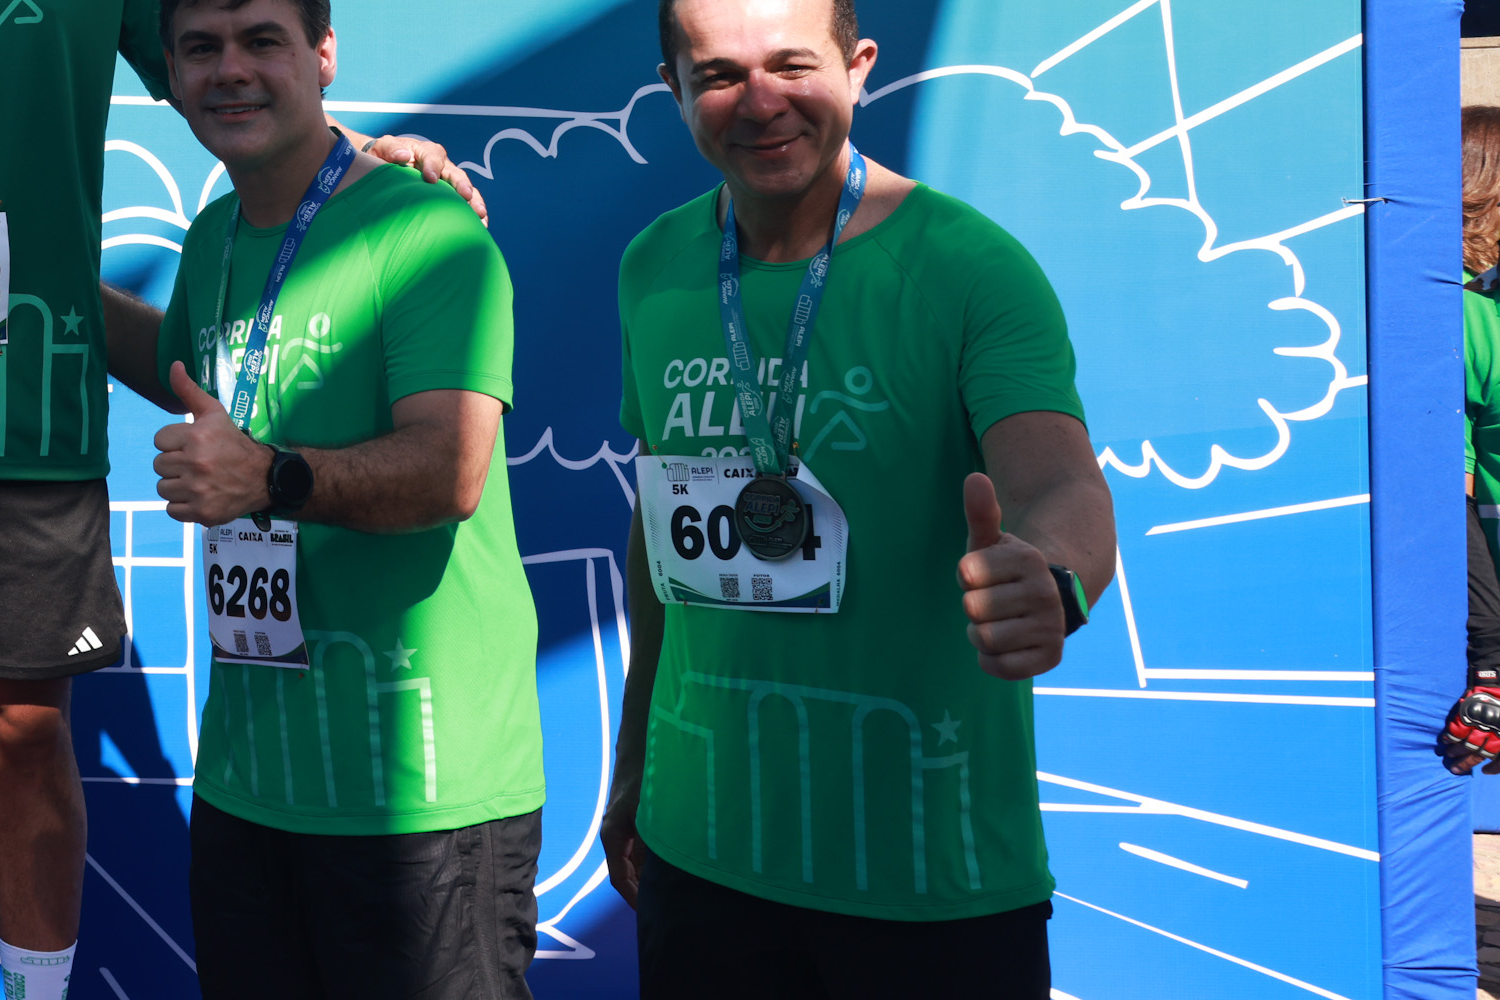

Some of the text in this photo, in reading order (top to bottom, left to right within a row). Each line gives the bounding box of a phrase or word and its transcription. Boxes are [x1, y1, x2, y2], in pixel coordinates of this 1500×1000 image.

[301, 202, 316, 221] ALEPI
[199, 315, 282, 352] CORIA
[728, 323, 736, 341] ALEPI
[796, 326, 806, 347] ALEPI
[201, 344, 280, 391] AEI
[250, 349, 259, 373] ALEPI
[664, 357, 808, 389] CORID
[662, 392, 806, 440] ALI
[745, 392, 756, 416] ALEPI
[777, 417, 786, 444] ALEPI
[724, 468, 760, 478] CAIX
[672, 484, 689, 495] 5K
[744, 501, 780, 516] ALEPI
[220, 528, 232, 536] ALEPI
[238, 532, 263, 542] CAIXA
[270, 533, 293, 543] BRASIL
[670, 504, 822, 560] 604
[209, 544, 218, 554] 5K
[208, 563, 292, 621] 6268
[660, 583, 671, 601] FRUTA
[13, 972, 25, 1000] CORRID
